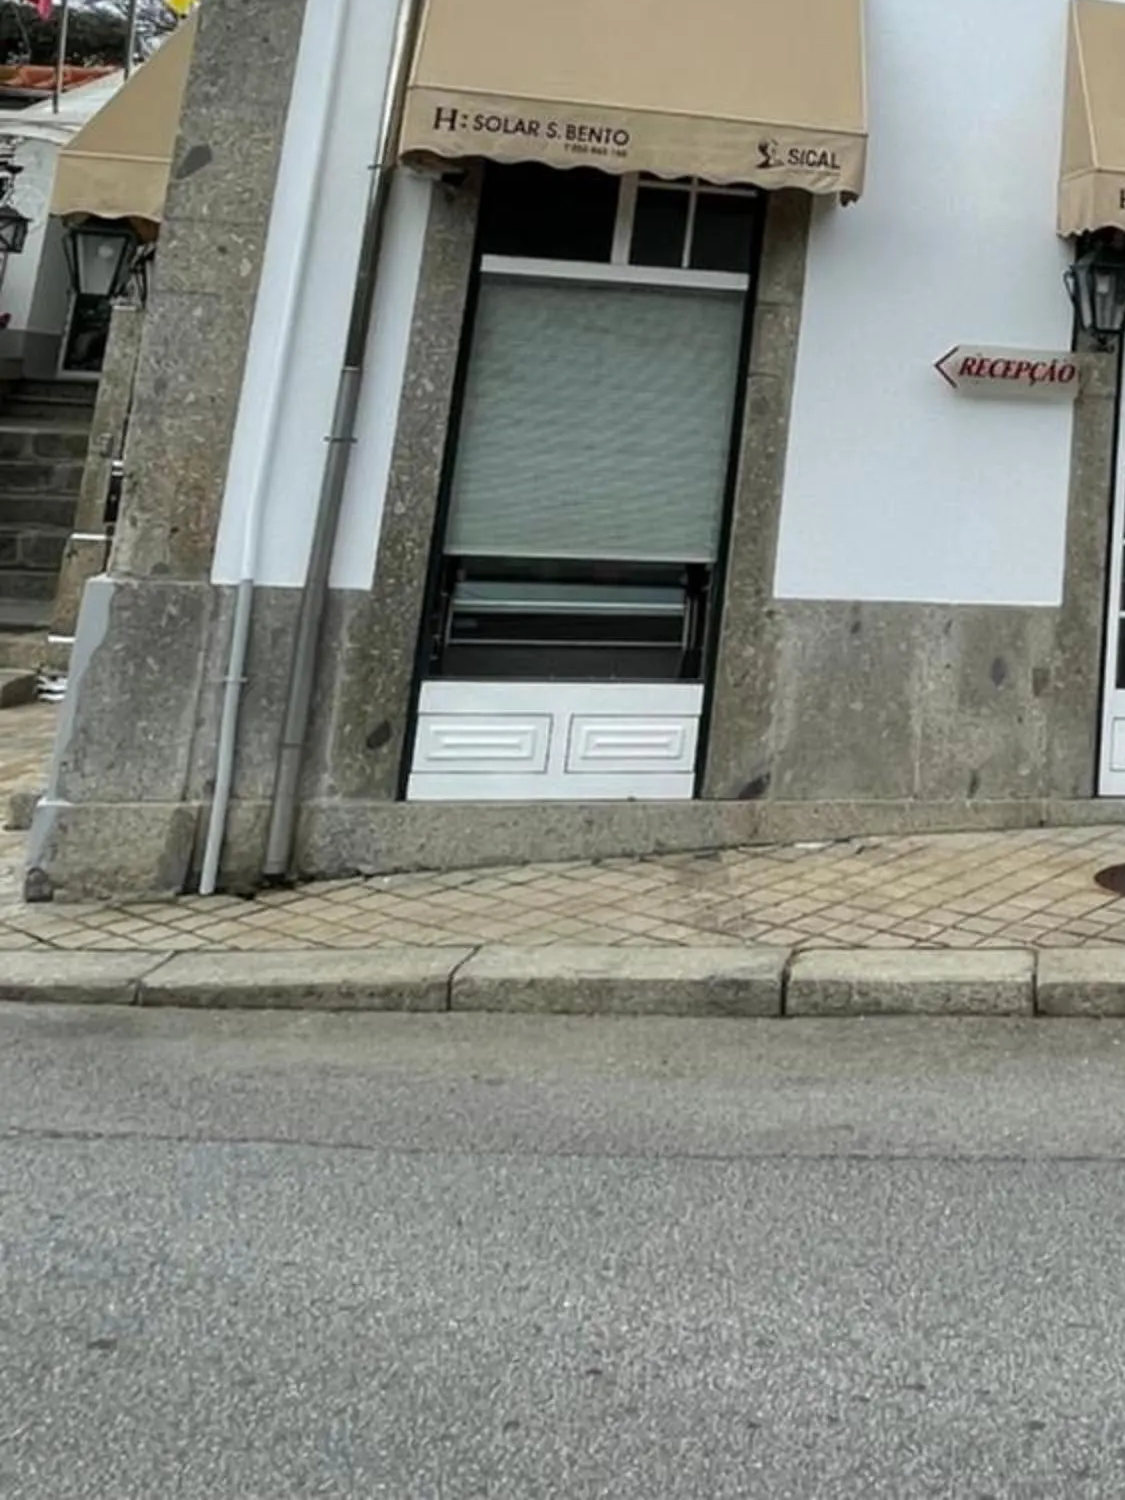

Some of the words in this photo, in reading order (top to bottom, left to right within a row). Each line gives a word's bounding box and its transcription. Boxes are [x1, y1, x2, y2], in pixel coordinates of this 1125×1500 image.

[473, 113, 541, 137] SOLAR
[545, 121, 562, 141] S.
[565, 123, 630, 146] BENTO
[787, 147, 841, 169] SICAL
